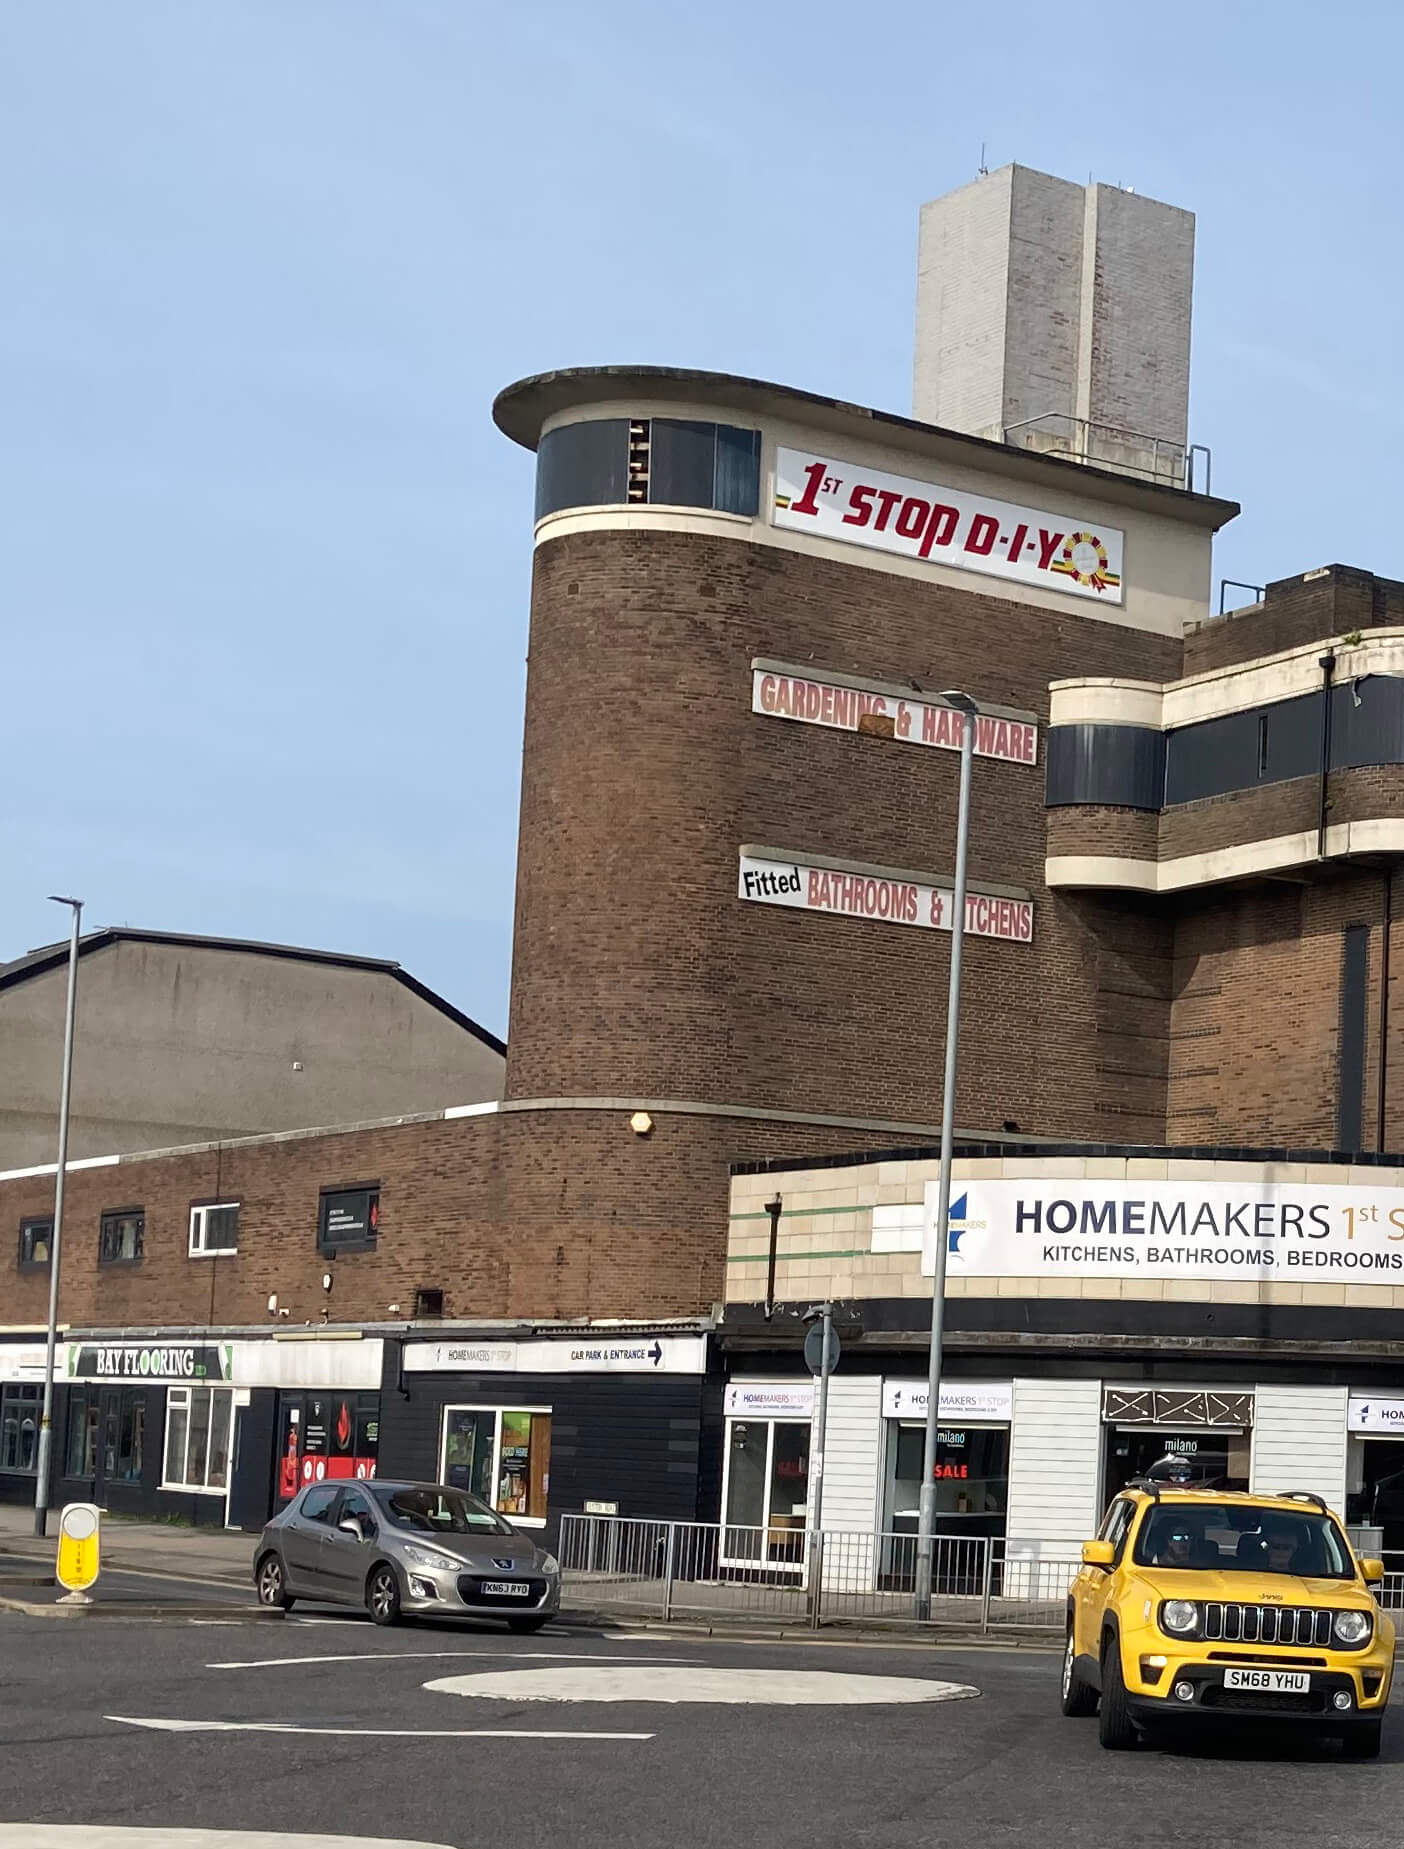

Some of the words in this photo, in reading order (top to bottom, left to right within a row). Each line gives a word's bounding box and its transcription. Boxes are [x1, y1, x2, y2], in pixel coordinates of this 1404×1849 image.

[842, 485, 960, 558] STOP
[897, 702, 912, 737] &
[922, 707, 1036, 761] HARWARE
[743, 867, 801, 898] Fitted
[807, 870, 918, 922] BATHROOMS
[930, 890, 943, 925] &
[953, 895, 1031, 939] TCHENS
[1016, 1199, 1330, 1240] HOMEMAKERS
[1342, 1204, 1379, 1240] 1st
[1043, 1245, 1140, 1265] KITCHENS,
[1147, 1247, 1280, 1268] BATHROOMS,
[1287, 1250, 1403, 1270] BEDROOMS
[96, 1349, 121, 1376] BAY
[123, 1349, 194, 1376] FLOORING
[571, 1350, 584, 1361] CAR
[585, 1350, 602, 1361] PARK
[603, 1349, 609, 1360] &
[610, 1349, 646, 1360] ENTRANCE
[743, 1393, 789, 1403] HOMEMAKERS
[911, 1395, 977, 1406] HOMAKERS
[1164, 1437, 1197, 1452] milano
[934, 1465, 968, 1478] SALE
[1231, 1671, 1271, 1687] SM68
[1275, 1674, 1304, 1689] YHU
